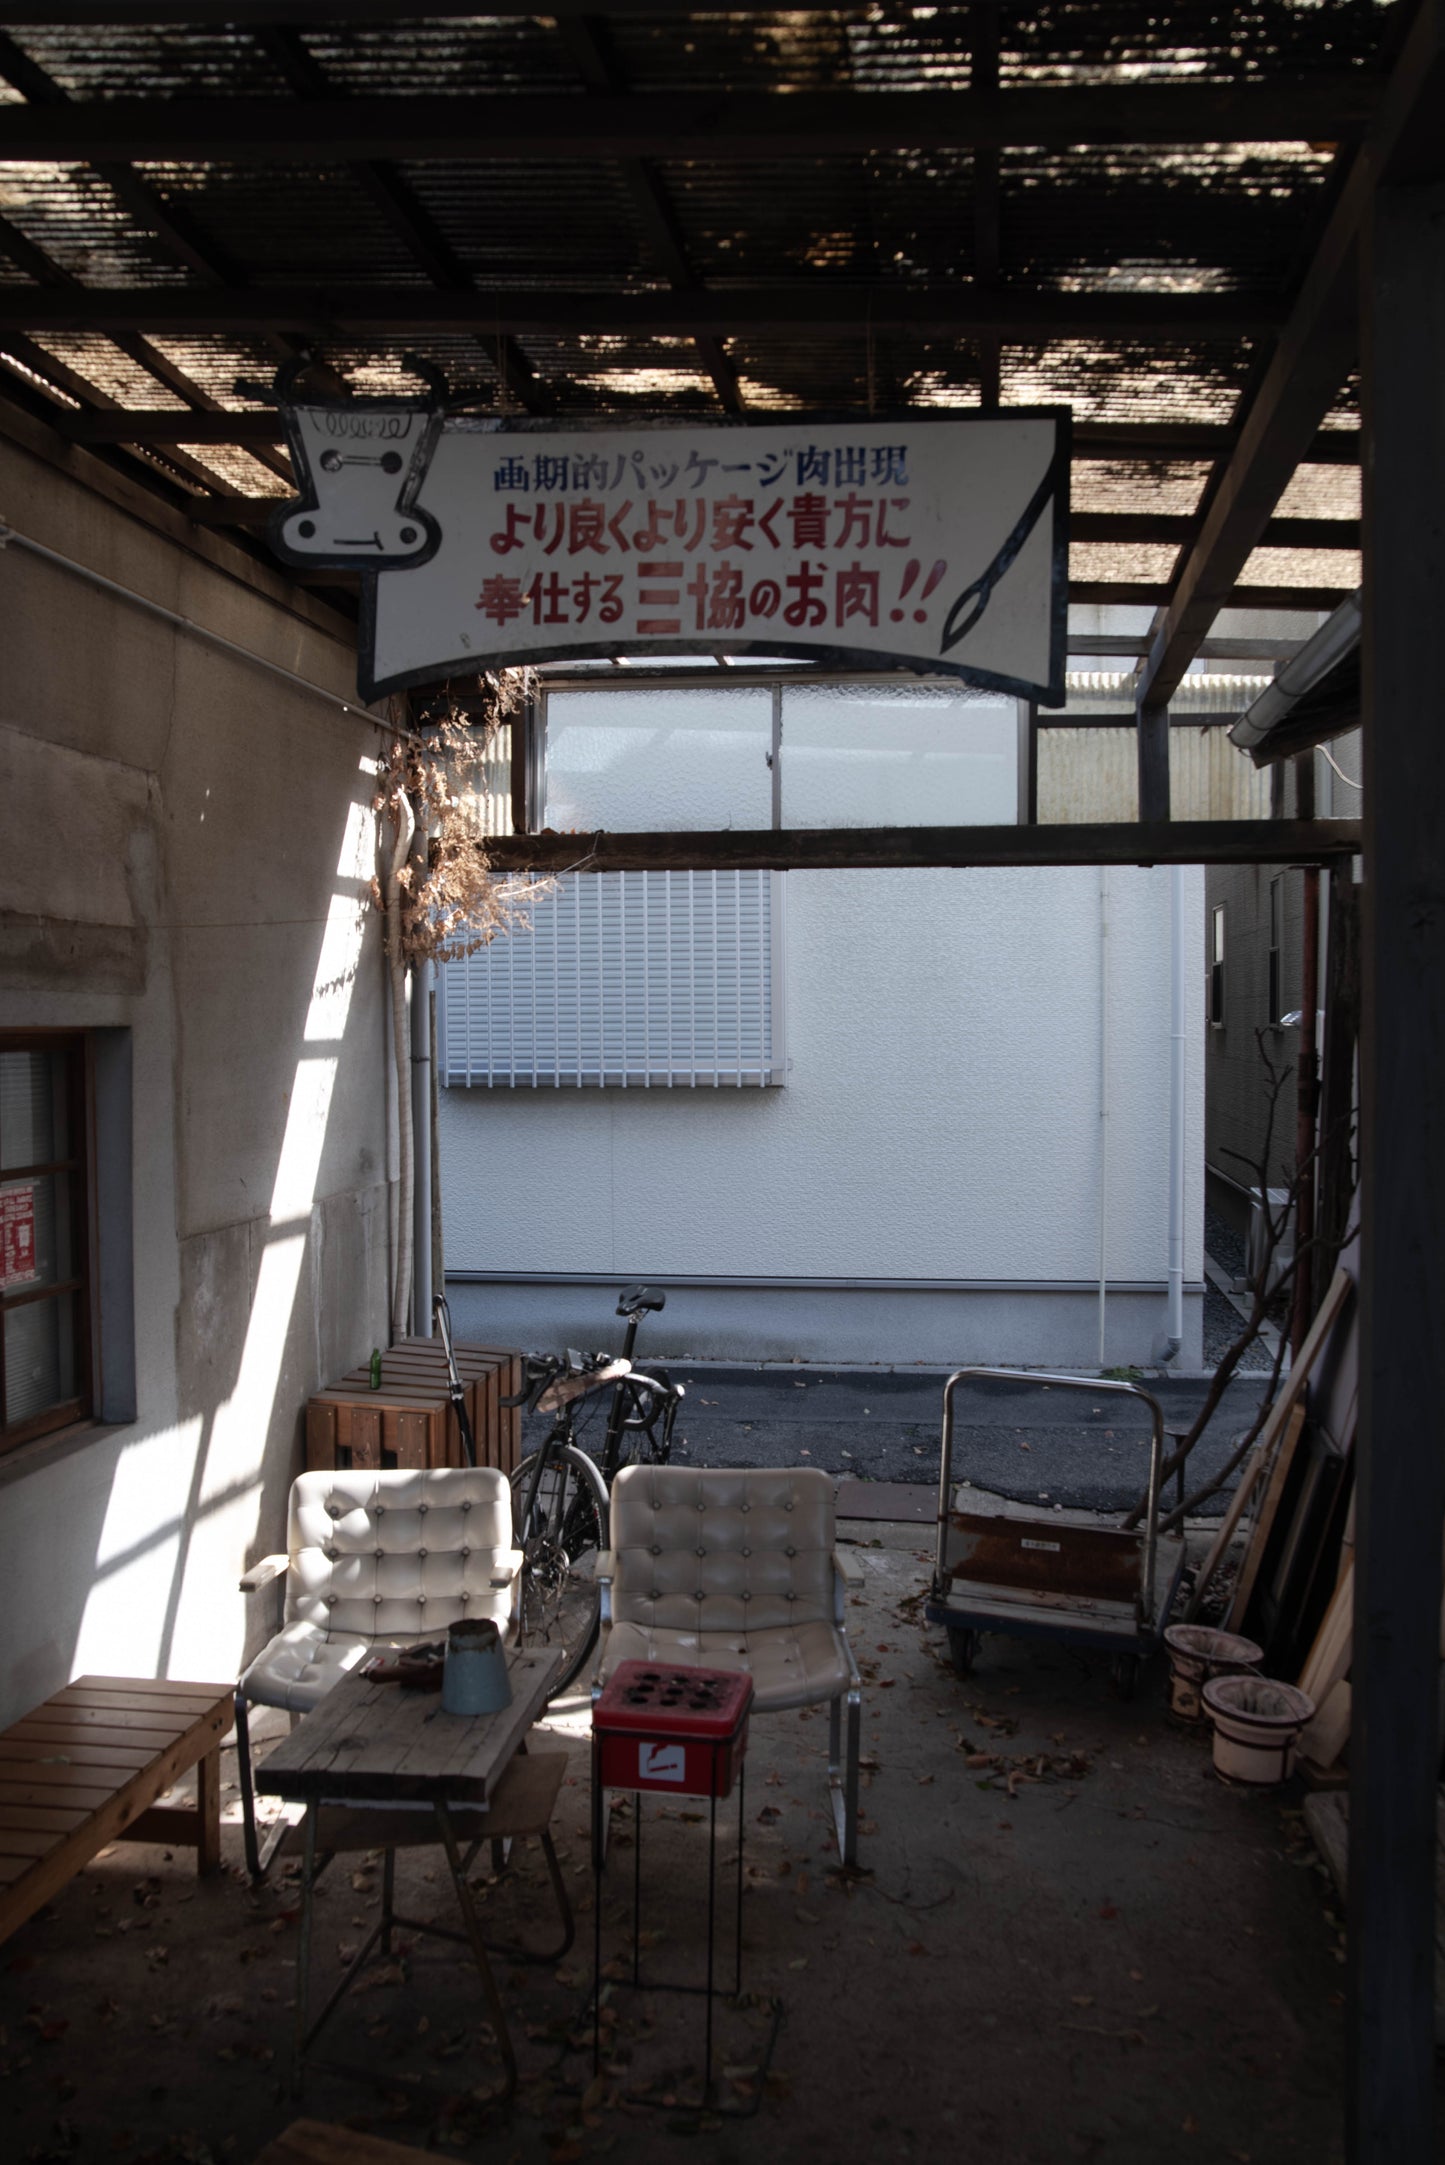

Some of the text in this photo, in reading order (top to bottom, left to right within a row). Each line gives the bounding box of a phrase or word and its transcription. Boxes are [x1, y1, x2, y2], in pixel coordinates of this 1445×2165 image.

[494, 445, 909, 493] 画期的パッケージ肉出現
[490, 492, 911, 555] より良くより安く貴方に
